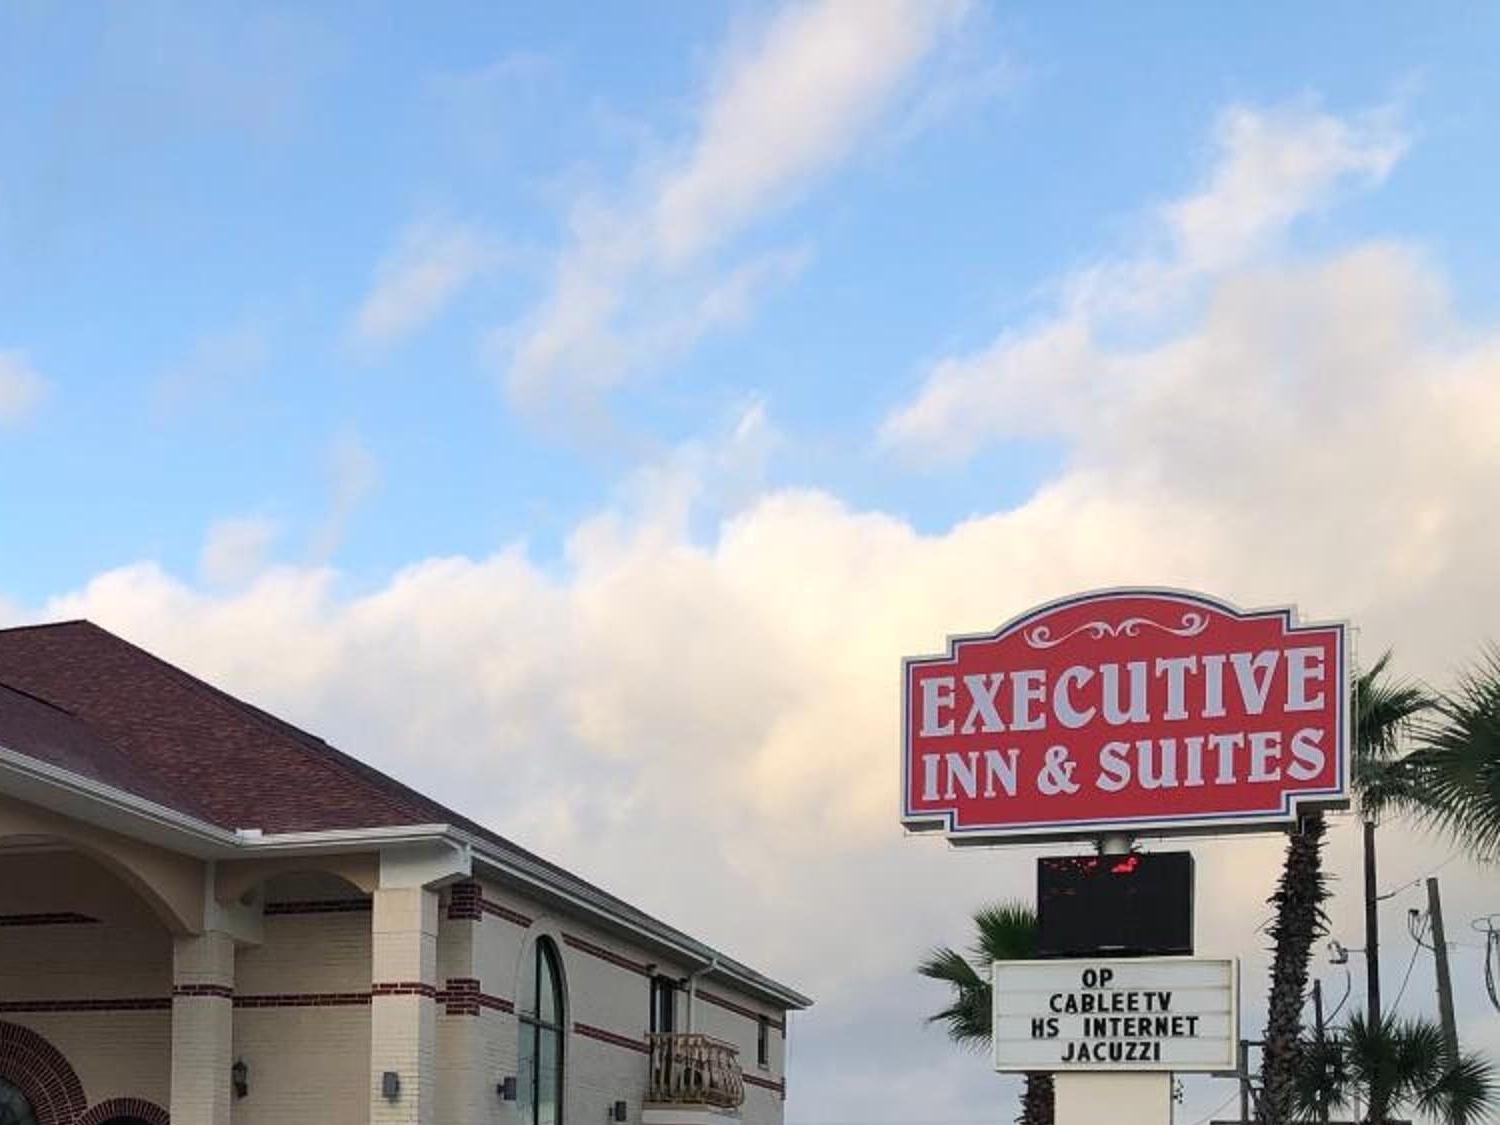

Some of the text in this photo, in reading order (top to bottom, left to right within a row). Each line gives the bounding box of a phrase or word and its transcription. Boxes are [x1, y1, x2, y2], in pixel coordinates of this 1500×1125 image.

[919, 646, 1326, 738] EXECUTIVE
[921, 728, 1326, 801] INN & SUITES
[1081, 968, 1114, 988] OP
[1031, 1015, 1199, 1039] HS INTERNET
[1060, 1041, 1161, 1062] JACUZZI
